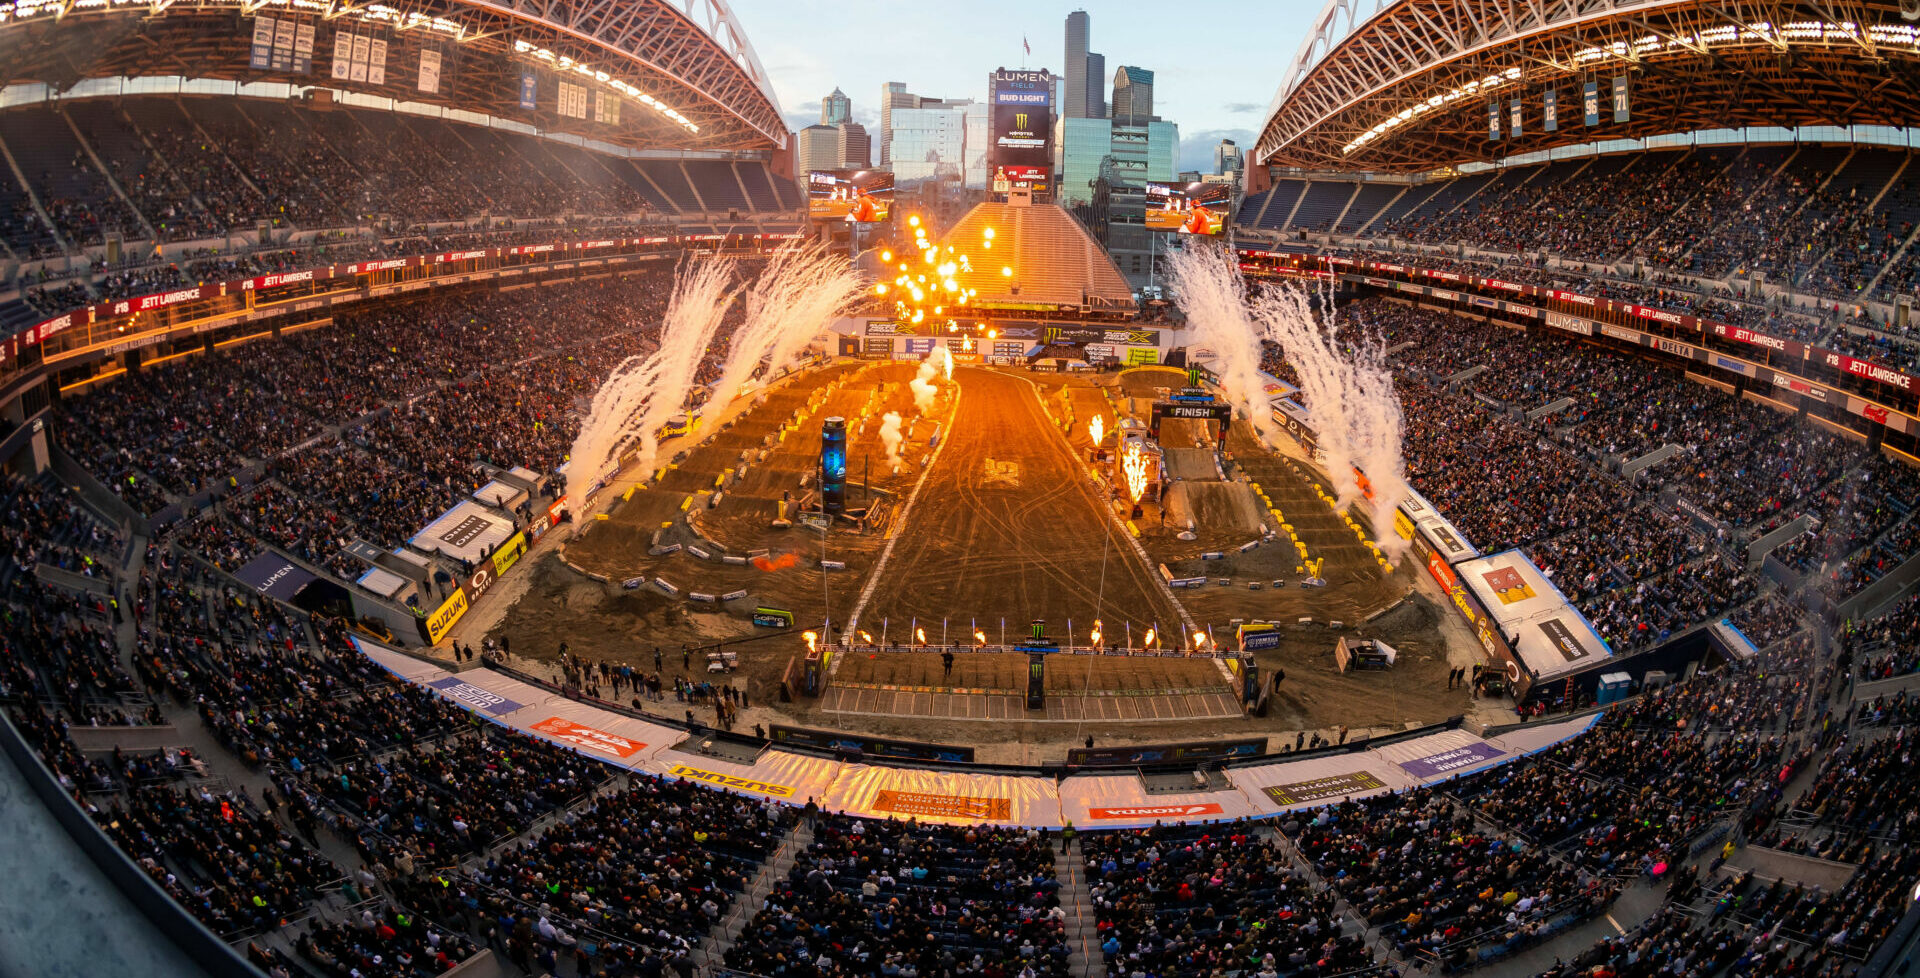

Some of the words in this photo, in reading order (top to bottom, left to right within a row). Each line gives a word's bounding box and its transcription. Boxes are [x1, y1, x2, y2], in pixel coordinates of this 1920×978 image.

[996, 73, 1048, 81] LUMEN
[1586, 99, 1597, 115] 96
[1616, 94, 1626, 111] 71
[1546, 106, 1554, 120] 12
[1490, 118, 1499, 132] 45
[451, 252, 462, 260] JETT
[462, 250, 486, 259] LAWRENCE
[534, 244, 554, 252] LAWRENCE
[365, 262, 378, 271] JETT
[378, 259, 406, 270] LAWRENCE
[242, 280, 254, 290] #18
[263, 275, 278, 287] JETT
[279, 271, 313, 284] LAWRENCE
[1441, 272, 1459, 281] LAWRENCE
[1492, 280, 1501, 288] JETT
[1501, 282, 1522, 291] LAWRENCE
[115, 302, 129, 315] #18
[141, 295, 159, 309] JETT
[160, 289, 200, 305] LAWRENCE
[1560, 291, 1571, 300] JETT
[1571, 294, 1595, 305] LAWRENCE
[1623, 305, 1632, 313] #18
[1639, 309, 1651, 317] JETT
[1651, 311, 1681, 324] LAWRENCE
[50, 315, 71, 335] LAWRENCE
[1548, 315, 1589, 334] LUMEN
[1715, 325, 1725, 334] #18
[1735, 329, 1749, 341] JETT
[1750, 333, 1785, 350] LAWRENCE
[1662, 341, 1689, 357] DELTA
[1827, 354, 1839, 365] #18
[1850, 359, 1868, 374] JETT
[1868, 364, 1910, 388] LAWRENCE
[1175, 408, 1210, 417] FINISH
[454, 517, 476, 537] OAKLEY
[464, 522, 488, 543] OAKLEY
[257, 565, 295, 592] LUMEN
[1435, 565, 1451, 589] HONDA
[471, 576, 492, 600] OAKLEY
[430, 595, 467, 637] SUZUKI
[754, 614, 784, 622] GoPro
[1256, 636, 1278, 644] YAMAHA
[1561, 636, 1581, 656] amazon
[1423, 750, 1457, 765] YAMAHA
[1435, 757, 1471, 772] YAMAHA
[676, 766, 788, 796] SUZUKI
[1287, 778, 1352, 793] MONSTER
[1298, 786, 1363, 801] MONSTER
